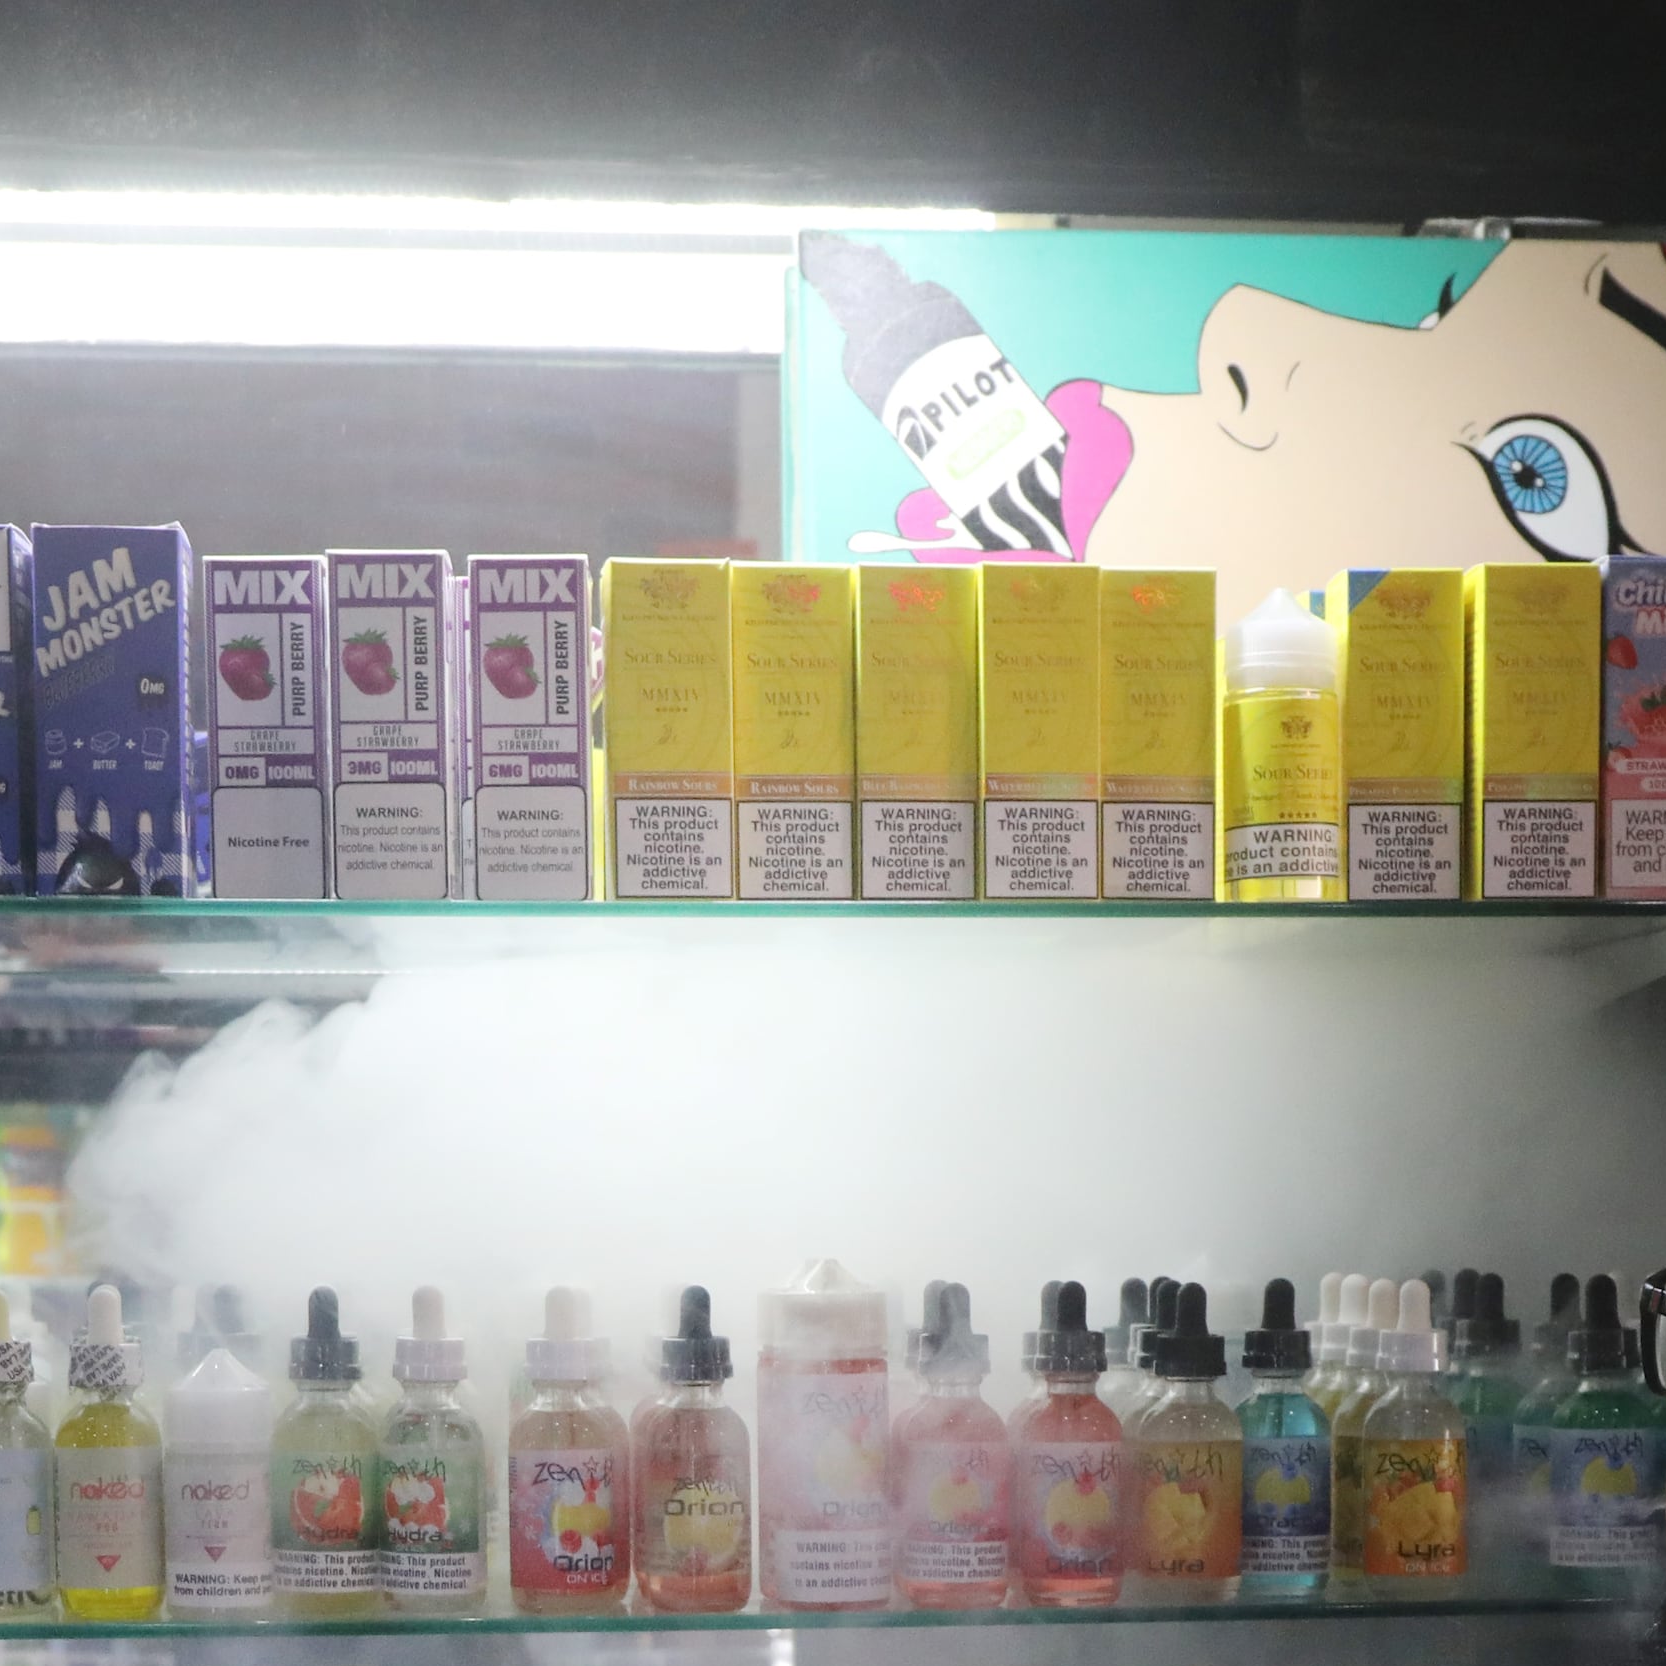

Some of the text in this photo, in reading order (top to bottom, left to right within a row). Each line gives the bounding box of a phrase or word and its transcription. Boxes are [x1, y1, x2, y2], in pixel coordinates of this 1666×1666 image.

[924, 358, 1017, 429] PILOT
[42, 547, 136, 632] JAM
[214, 570, 310, 606] MIX
[337, 564, 433, 599] MIX
[479, 568, 574, 603] MIX
[37, 580, 175, 677] MONSTER
[289, 621, 307, 718] PURP BERRY
[412, 615, 429, 713] PURP BERRY
[554, 619, 571, 716] PURP BERRY
[228, 835, 310, 849] Nicotine Free
[1616, 842, 1652, 857] from
[1625, 826, 1662, 844] Keep
[1635, 858, 1662, 872] and
[664, 1500, 745, 1518] Orion
[1399, 1540, 1455, 1562] Lyra
